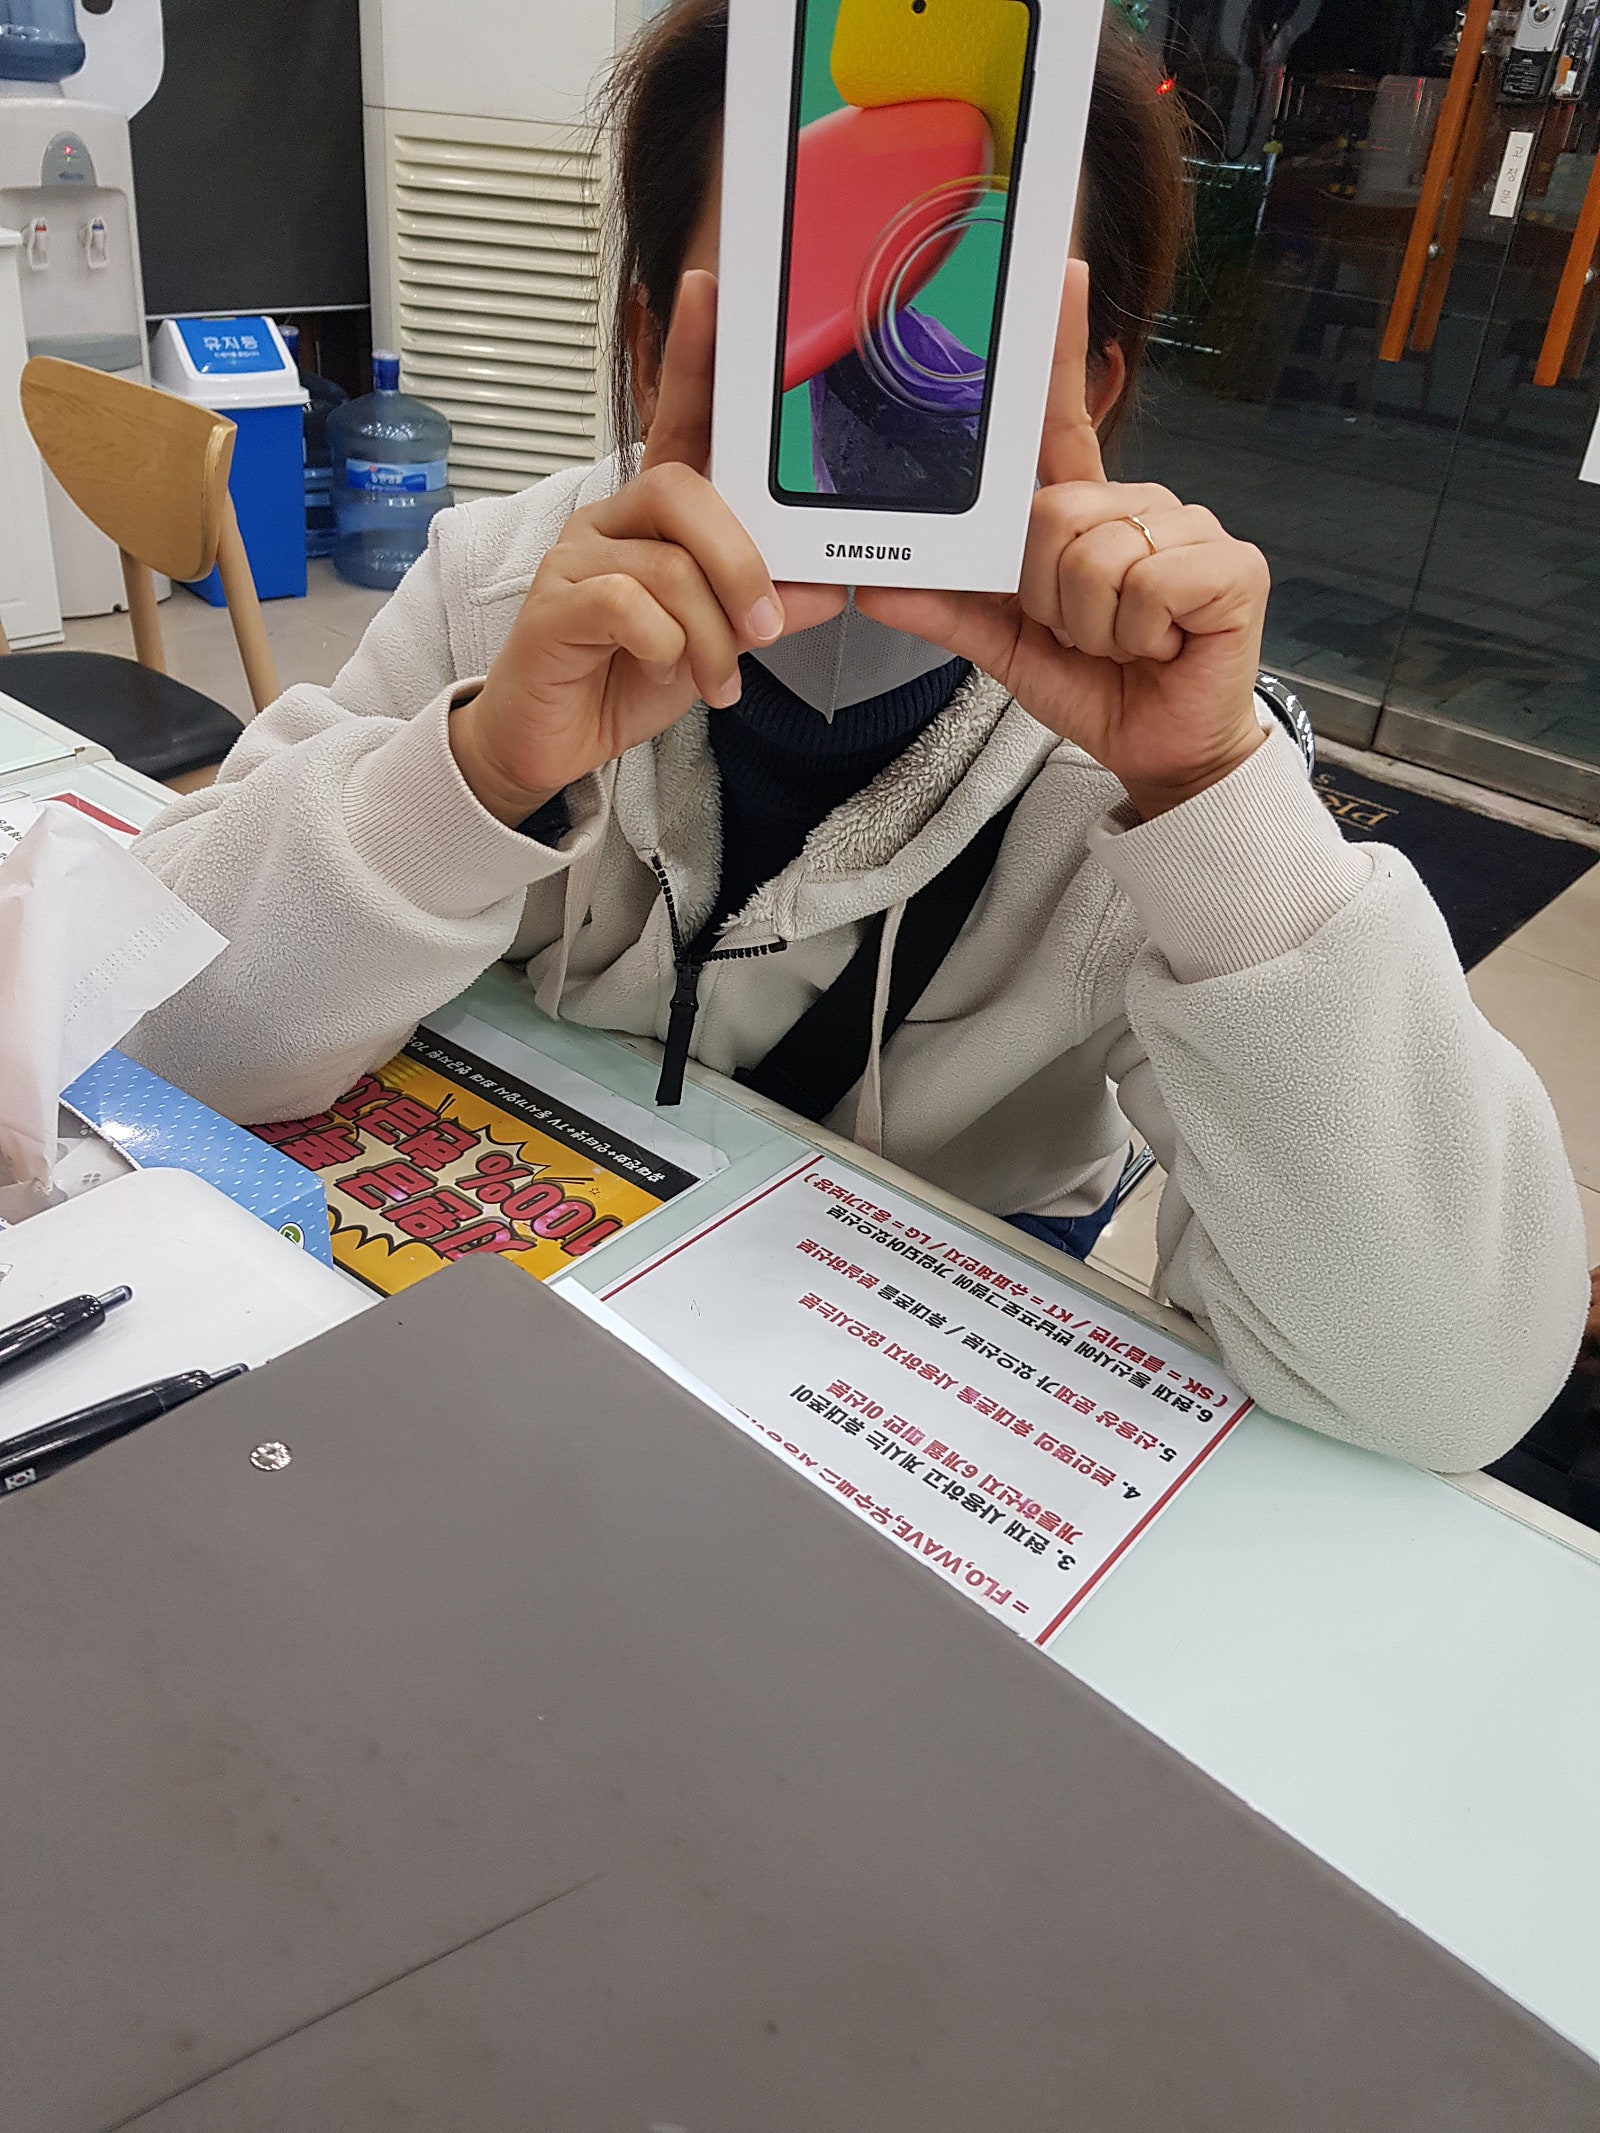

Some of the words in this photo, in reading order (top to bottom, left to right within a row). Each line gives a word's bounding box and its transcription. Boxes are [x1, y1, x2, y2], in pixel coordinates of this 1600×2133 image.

[825, 543, 912, 561] SAMSUNG
[426, 1049, 473, 1075] 현금지원
[468, 1073, 498, 1088] 최대
[493, 1087, 553, 1119] 동시가입시
[546, 1118, 666, 1183] 휴대전화+인터넷+TV
[455, 1151, 620, 1257] 100%
[812, 1178, 892, 1224] 중고가보장
[825, 1204, 955, 1279] 가입되어있으신분
[904, 1226, 932, 1246] LG
[796, 1238, 881, 1289] 분실하신분
[941, 1247, 1029, 1297] 슈퍼체인지
[798, 1292, 887, 1348] 않으시는분
[877, 1284, 948, 1329] 휴대폰을
[951, 1273, 1076, 1347] 반납프로그램에
[1041, 1303, 1075, 1324] KT
[882, 1342, 959, 1390] 사용하지
[960, 1332, 1038, 1380] 있으신분
[1073, 1340, 1152, 1390] 통신사에
[1087, 1325, 1167, 1374] 클럽기변
[789, 1384, 866, 1436] 휴대폰이
[825, 1379, 884, 1420] 이신분
[956, 1385, 1035, 1438] 휴대폰을
[1035, 1375, 1097, 1416] 문제가
[1151, 1383, 1214, 1423] 6.현재
[1181, 1376, 1215, 1401] SK
[865, 1430, 926, 1475] 계시는
[882, 1414, 926, 1447] 미만
[1095, 1410, 1177, 1463] 5.신용상
[922, 1439, 979, 1479] 6개월
[1033, 1431, 1117, 1487] 본인명의
[921, 1467, 1007, 1525] 사용하고
[977, 1473, 1083, 1546] 개통하신지
[1122, 1481, 1142, 1500] 4.
[1003, 1519, 1051, 1555] 현재
[1057, 1549, 1076, 1571] 3.
